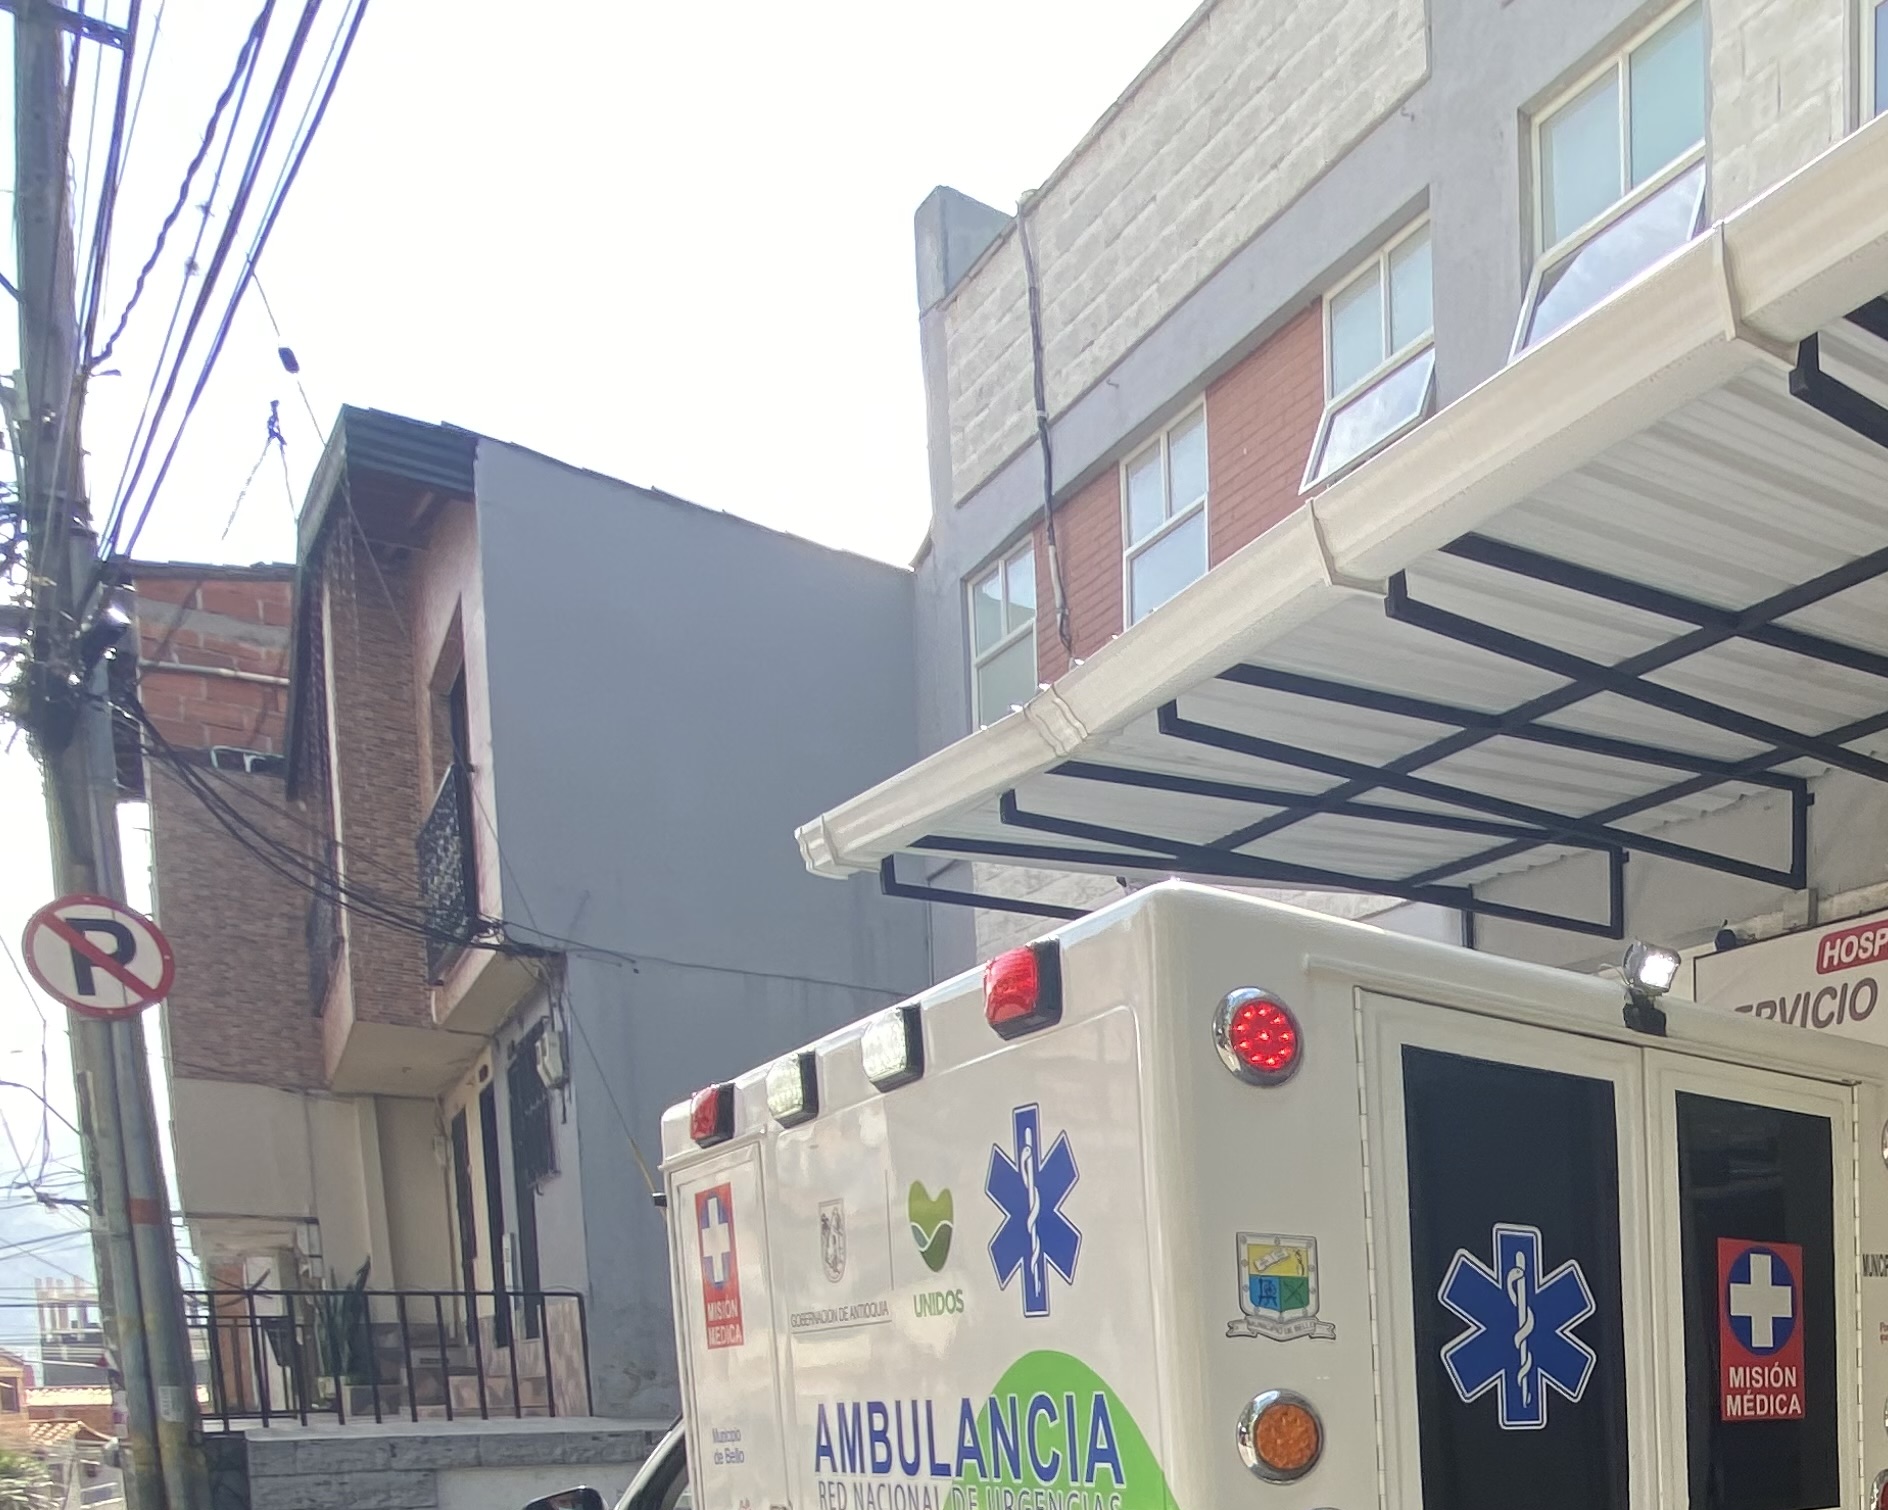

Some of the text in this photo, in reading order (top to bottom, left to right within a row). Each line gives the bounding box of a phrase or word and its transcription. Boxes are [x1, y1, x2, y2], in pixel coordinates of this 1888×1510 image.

[1734, 977, 1879, 1029] VICIO
[913, 1288, 965, 1318] UNIDOS
[1729, 1361, 1797, 1388] MISIÓN
[1726, 1389, 1802, 1417] MÉDICA
[814, 1392, 1126, 1486] AMBULANCIA
